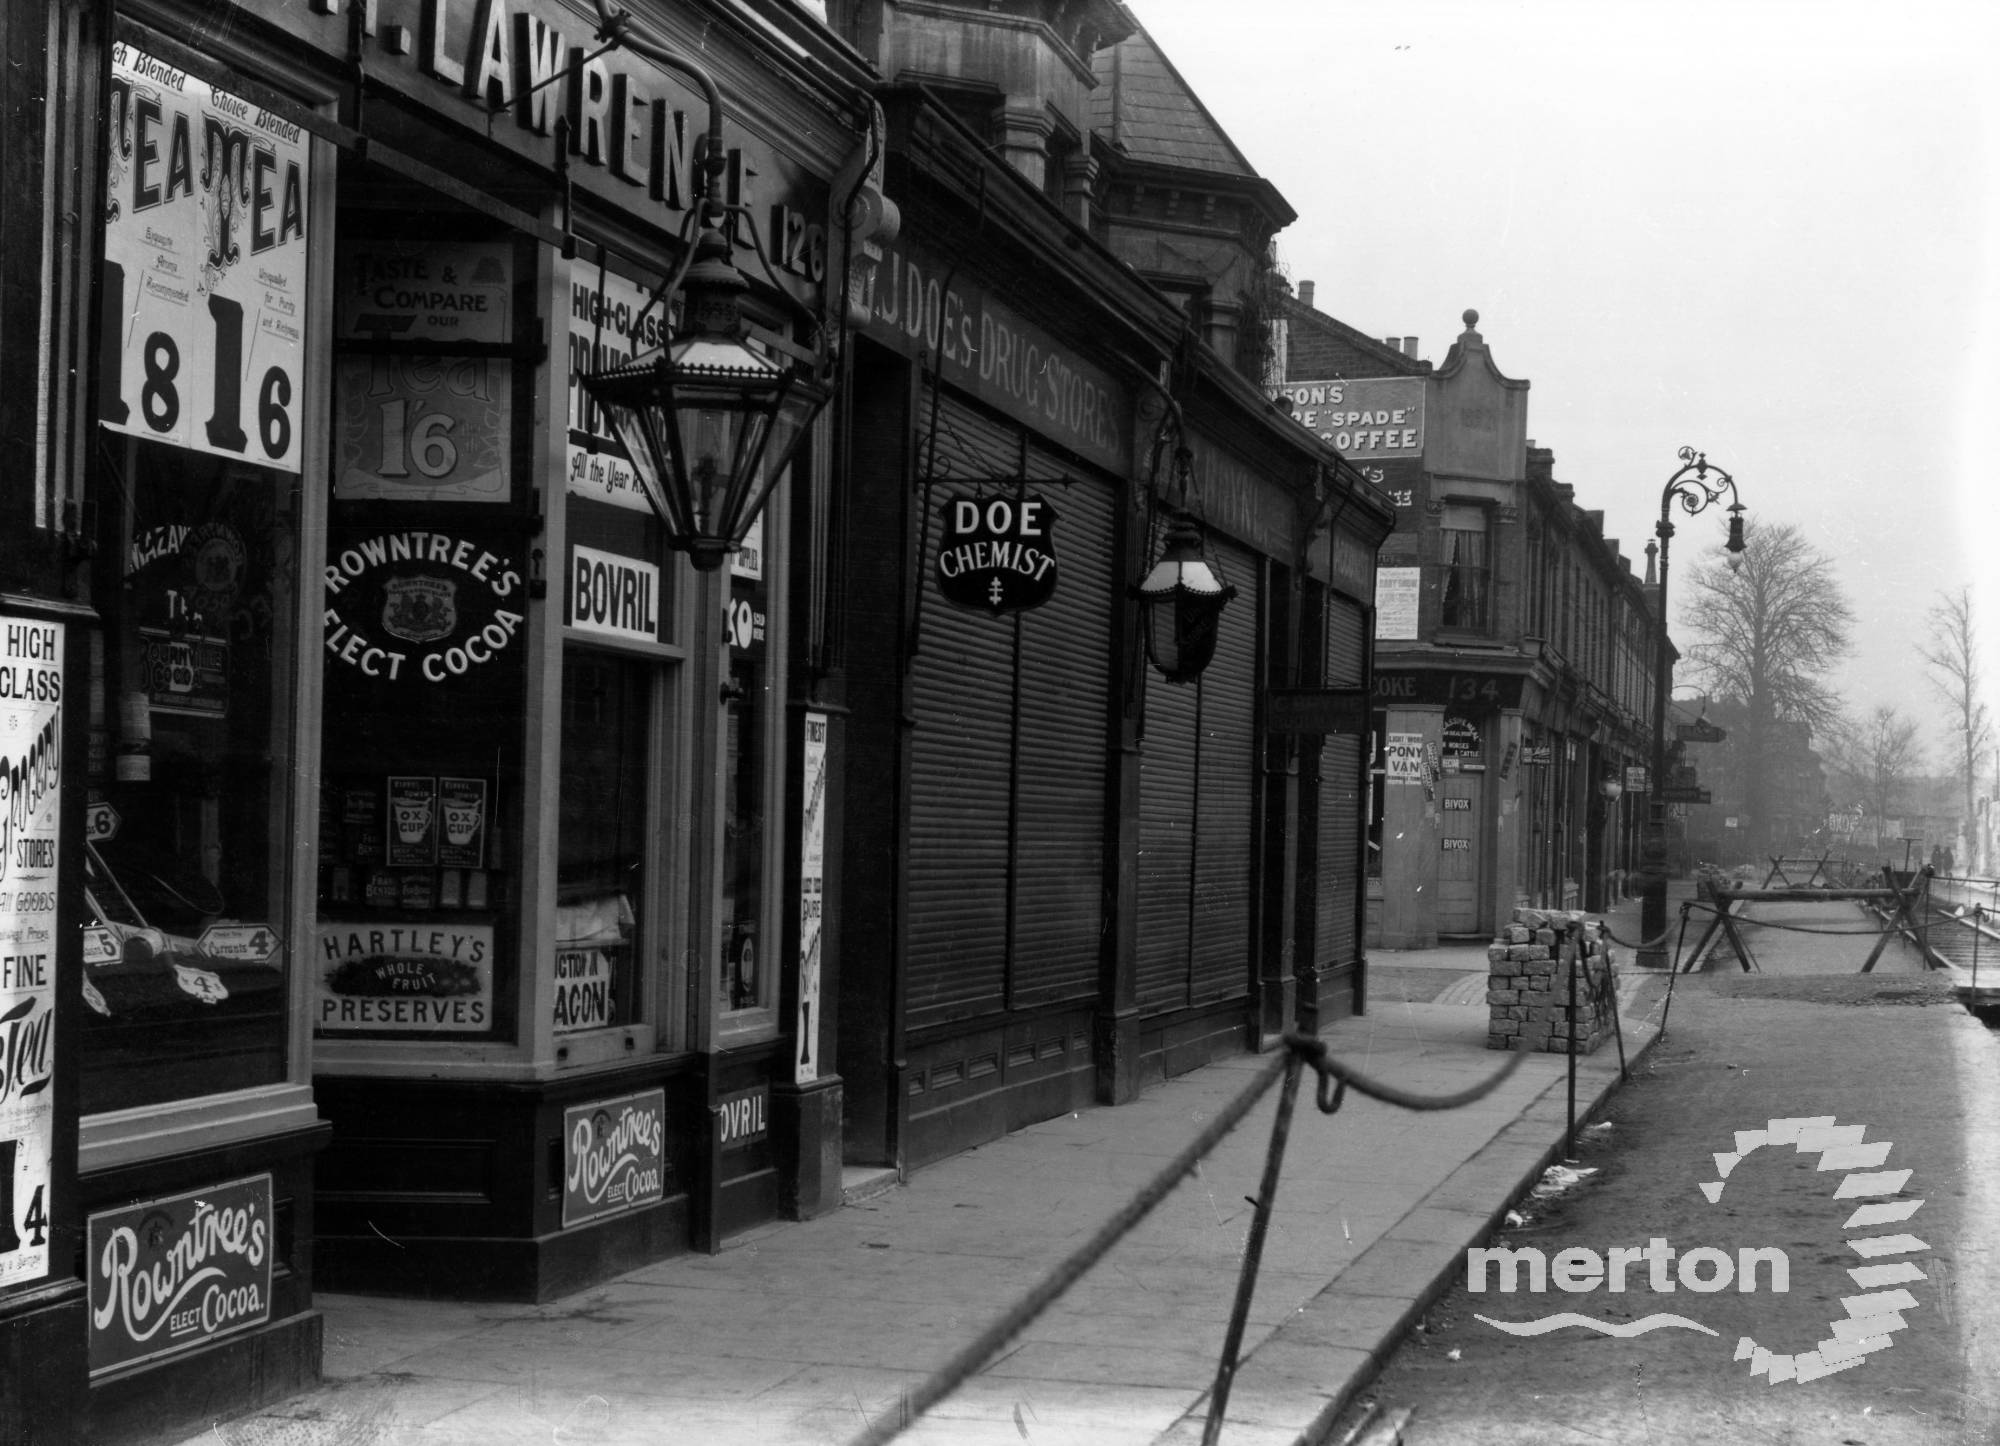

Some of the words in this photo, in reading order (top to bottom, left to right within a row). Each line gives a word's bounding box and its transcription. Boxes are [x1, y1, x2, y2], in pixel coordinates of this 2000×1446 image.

[133, 50, 188, 92] Blended
[209, 84, 247, 121] Choice
[254, 107, 301, 144] Blended
[434, 0, 766, 250] LAWRENE
[778, 203, 824, 284] 126
[201, 110, 304, 271] TEA
[354, 252, 428, 296] TASTE
[441, 266, 457, 285] &
[374, 285, 488, 312] COMPARE
[427, 315, 458, 326] OUR
[906, 262, 972, 369] DOE'S
[979, 309, 1038, 409] DRUG
[1046, 353, 1120, 457] STORES
[571, 452, 587, 482] All
[590, 457, 604, 483] the
[606, 460, 629, 493] Year
[956, 501, 1042, 536] DOE
[324, 531, 521, 596] ROWNTREE'S
[939, 541, 1055, 582] CHEMIST
[576, 556, 655, 634] BOVRIL
[8, 625, 55, 661] HIGH
[422, 609, 524, 682] COCOA
[0, 667, 60, 702] CLASS
[1449, 676, 1499, 701] 134
[1389, 746, 1423, 757] PONY
[1392, 761, 1419, 772] VAN
[400, 811, 422, 820] OX
[449, 812, 470, 822] OX
[1444, 799, 1469, 809] BIVOX
[95, 810, 110, 834] 6
[399, 823, 424, 832] CUP
[448, 824, 473, 834] CUP
[17, 839, 55, 869] STORES
[1443, 839, 1469, 849] BIVOX
[16, 891, 55, 912] GOODS
[98, 933, 116, 956] 5
[208, 941, 248, 958] Currants
[249, 931, 269, 954] 4
[323, 930, 485, 962] HARTLEY'S
[3, 954, 47, 988] FINE
[193, 976, 212, 993] 4
[375, 962, 424, 980] WHOLE
[391, 972, 437, 991] FRUIT
[322, 999, 484, 1023] PRESERVES
[553, 981, 606, 1025] ACON
[720, 1095, 765, 1142] OVRIL
[568, 1106, 661, 1204] Rowntree's
[607, 1182, 625, 1198] ELECT
[94, 1201, 266, 1341] Rowntree's
[169, 1307, 201, 1332] ELECT
[201, 1283, 264, 1333] Cocoa.
